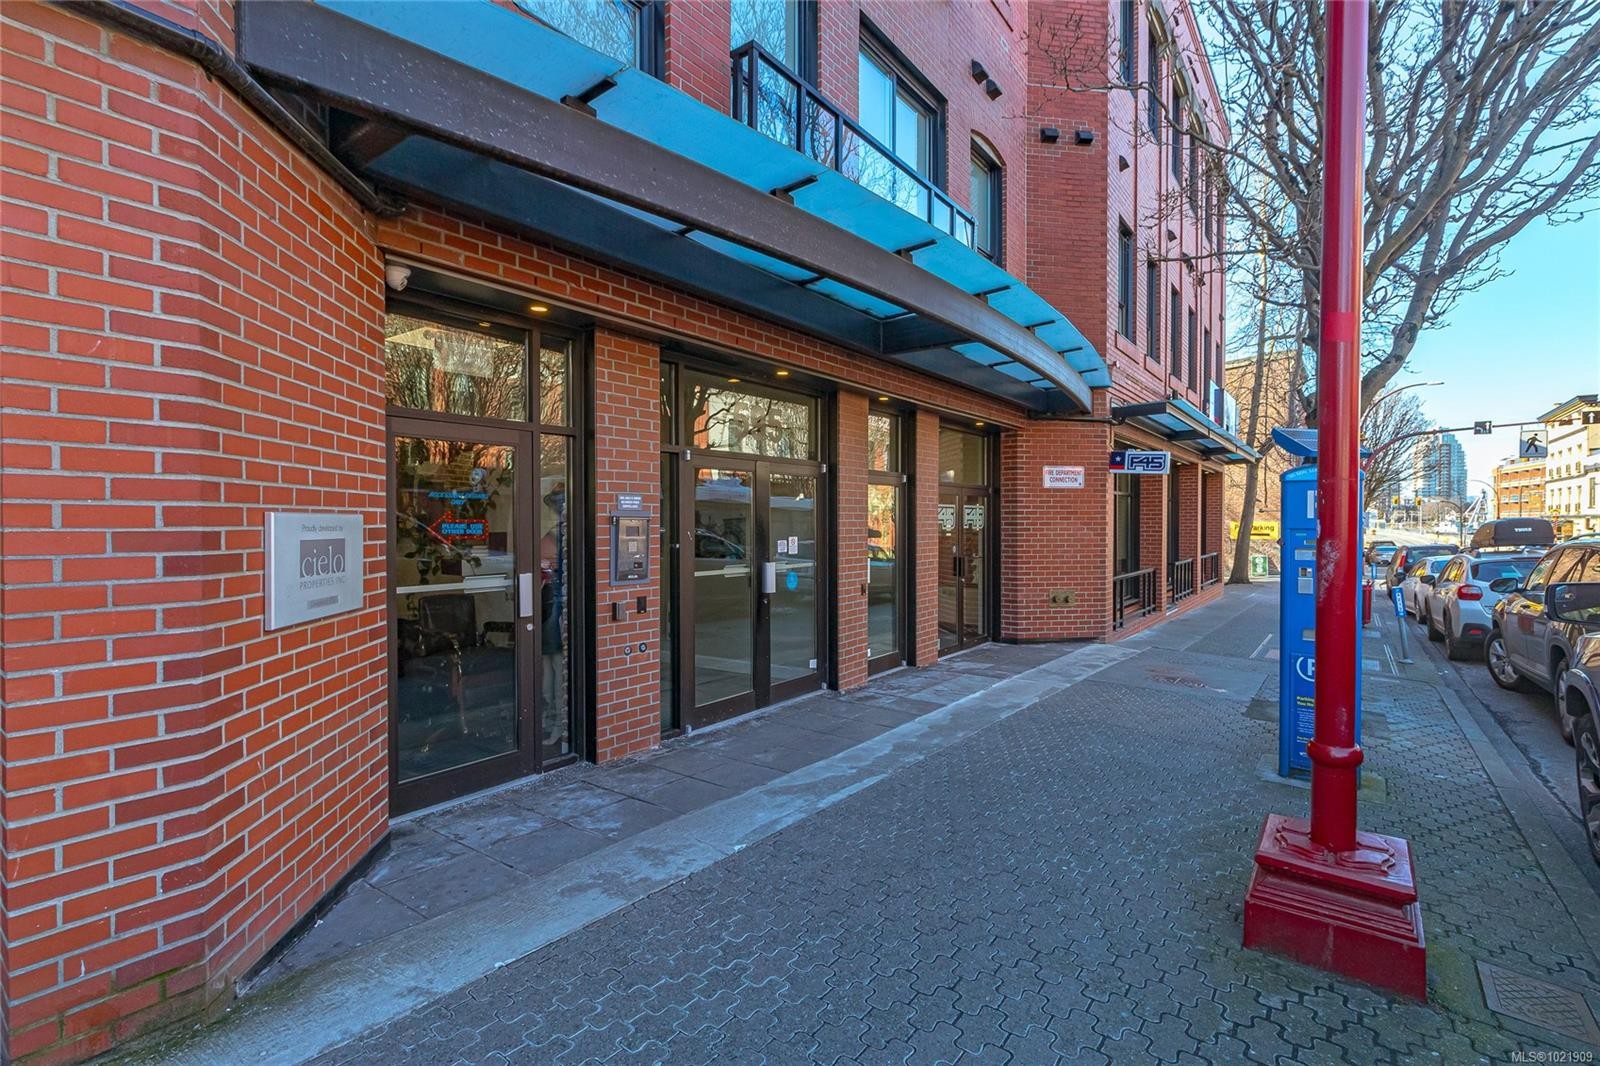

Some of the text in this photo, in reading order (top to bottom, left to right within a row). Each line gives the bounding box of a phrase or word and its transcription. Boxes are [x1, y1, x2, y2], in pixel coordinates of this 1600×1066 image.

[1128, 453, 1166, 471] F45
[938, 504, 955, 529] 45
[302, 545, 344, 578] cielo
[299, 577, 334, 590] PROPERTIES
